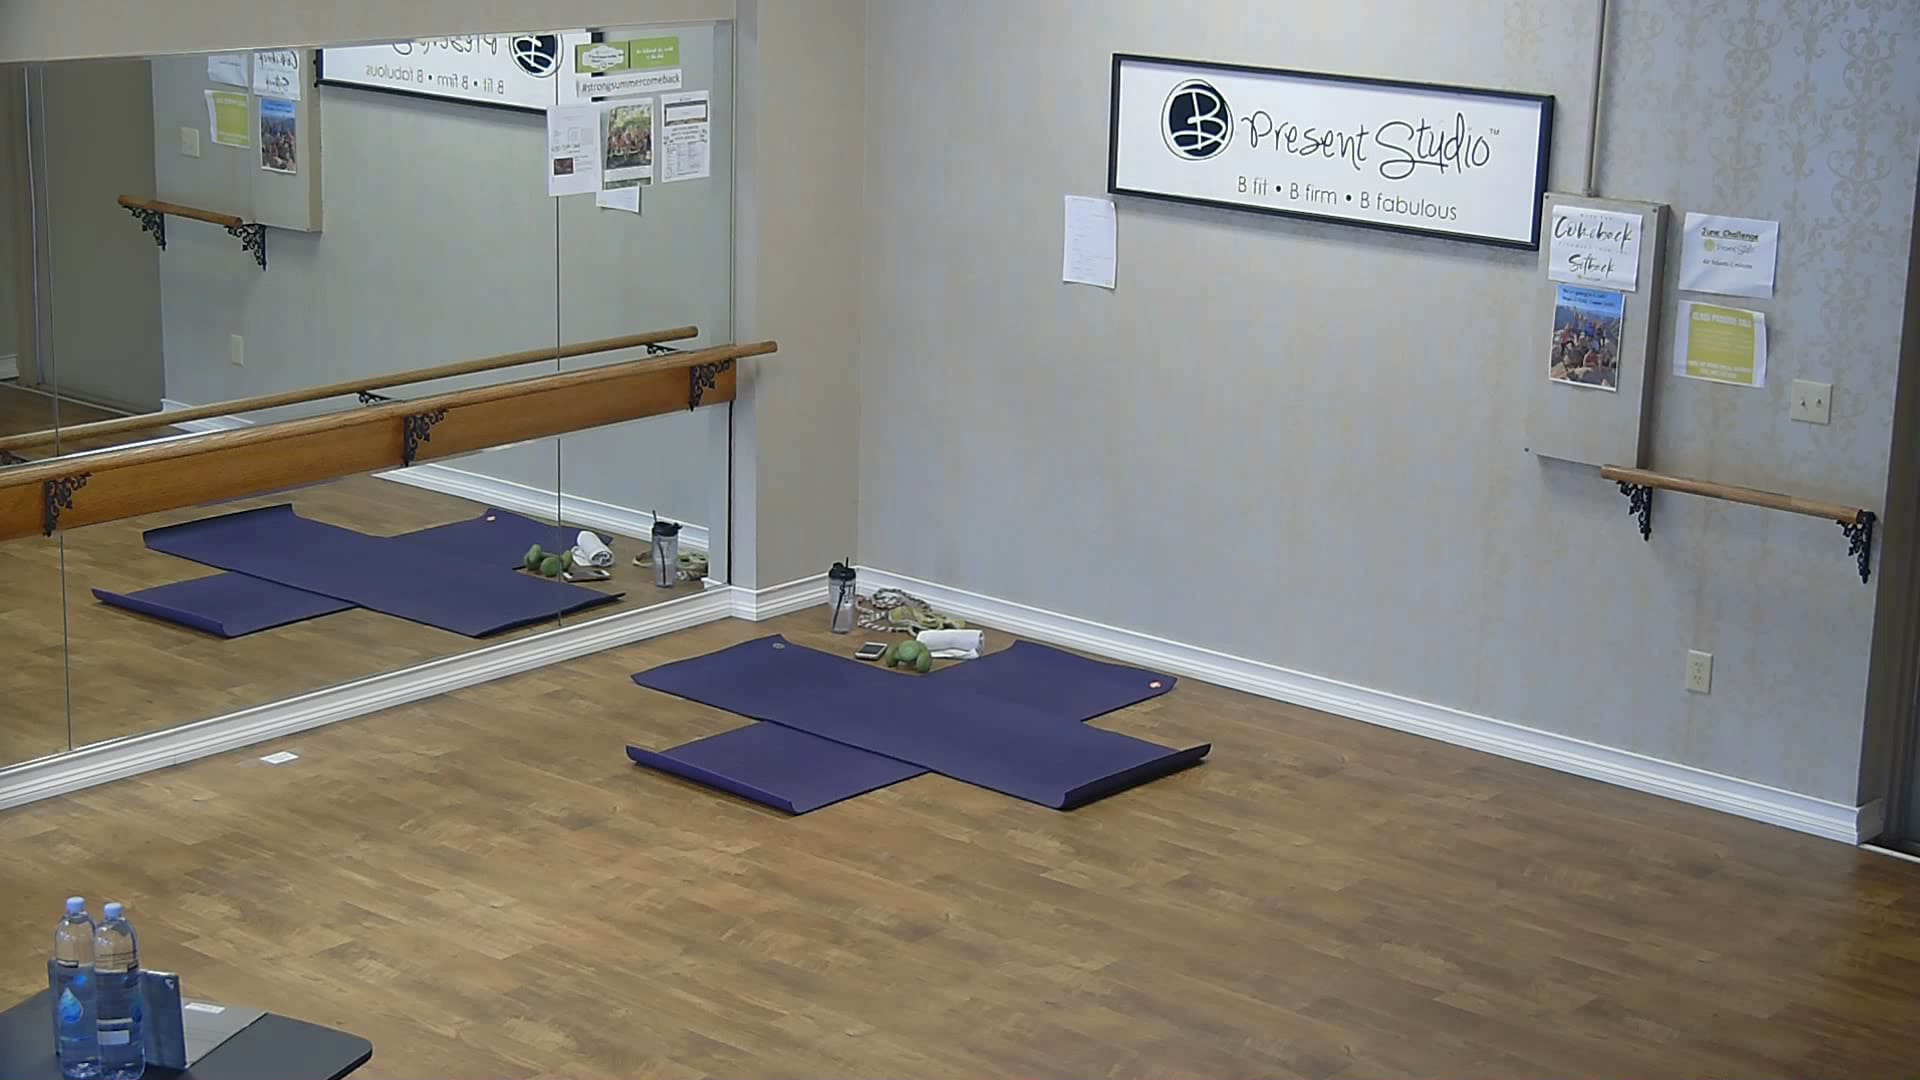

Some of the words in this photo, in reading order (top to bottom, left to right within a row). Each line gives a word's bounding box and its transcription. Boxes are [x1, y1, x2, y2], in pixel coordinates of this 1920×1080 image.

[582, 73, 681, 94] #strongsummercomeback
[1240, 110, 1370, 171] Present
[1375, 112, 1490, 180] Studio
[1237, 175, 1248, 193] B
[1252, 177, 1269, 196] fit
[1289, 181, 1300, 200] B
[1304, 183, 1338, 205] firm
[1359, 190, 1371, 210] B
[1376, 192, 1458, 221] fabulous
[1722, 229, 1760, 243] Challenge
